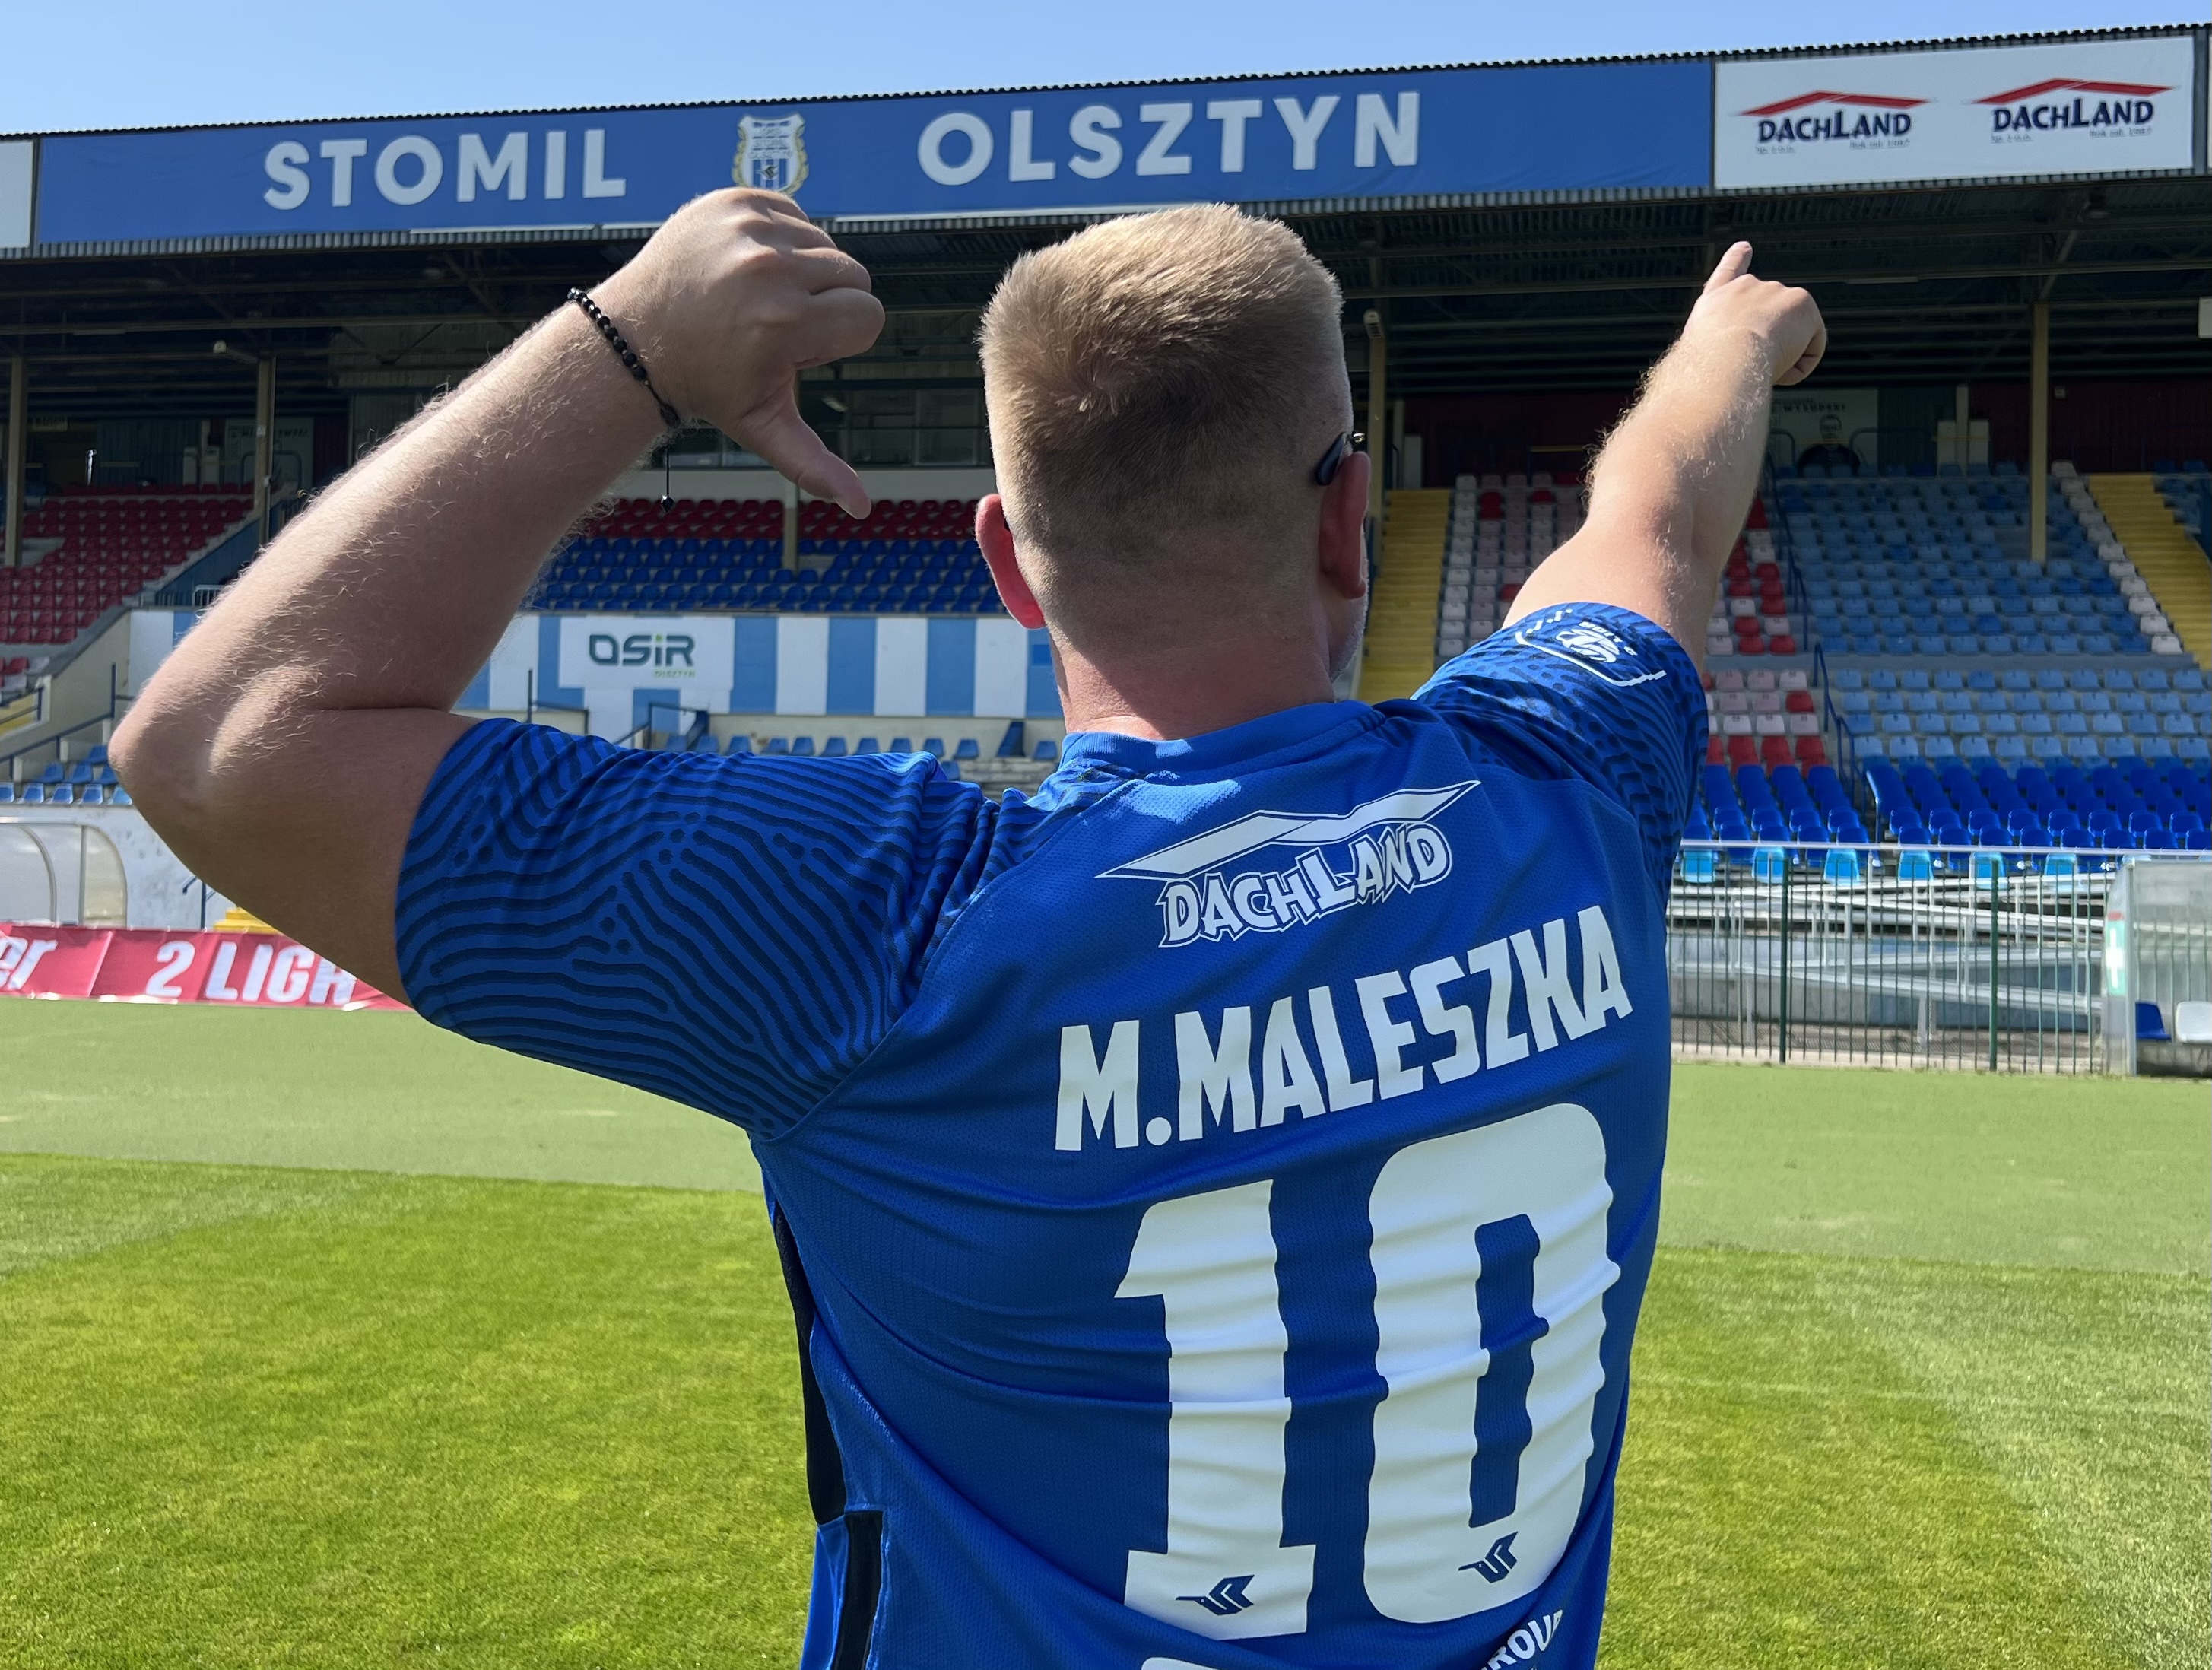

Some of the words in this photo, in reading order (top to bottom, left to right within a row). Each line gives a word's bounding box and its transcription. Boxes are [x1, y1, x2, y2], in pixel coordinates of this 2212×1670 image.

[263, 129, 627, 210] STOMIL
[916, 90, 1420, 186] OLSZTYN
[1757, 109, 1912, 143] DACHLAND
[1992, 97, 2154, 132] DACHLAND
[1157, 821, 1453, 948] DACHLAND
[145, 941, 196, 997] 2
[1055, 905, 1633, 1151] M.MALESZKA
[1113, 1103, 1622, 1641] 10
